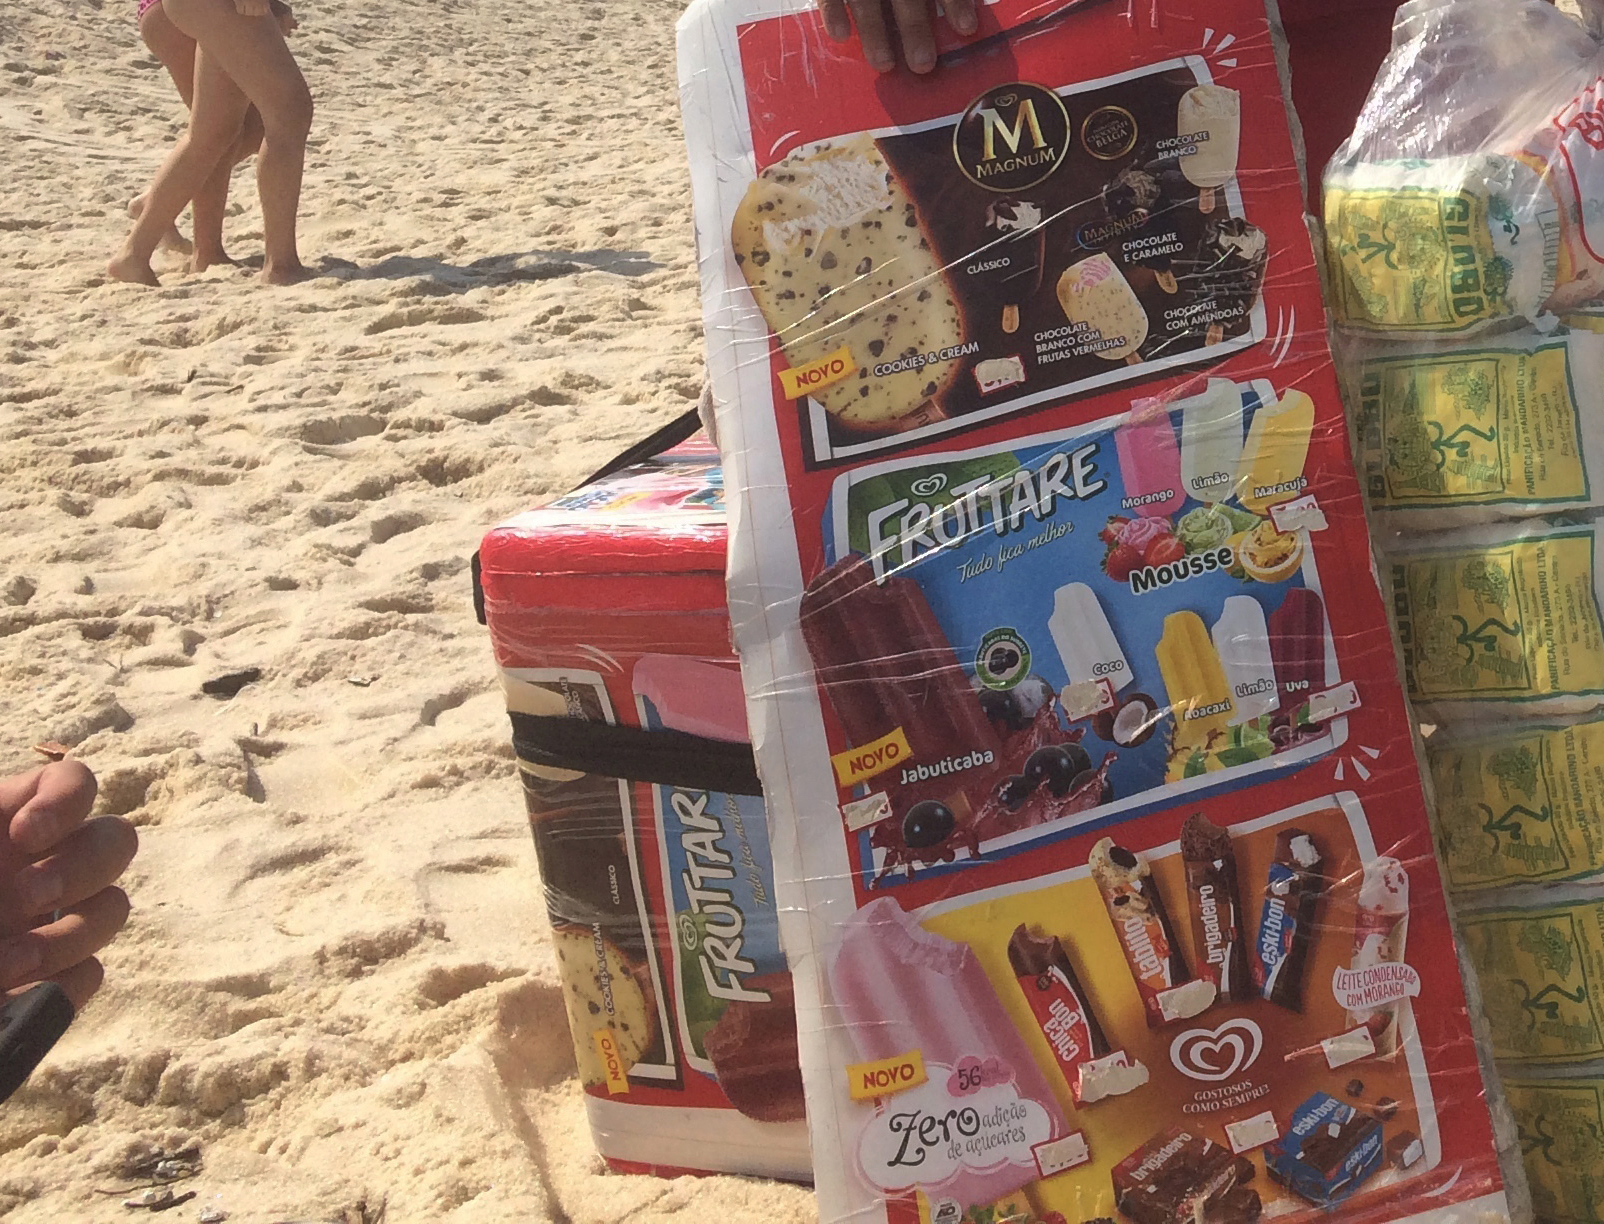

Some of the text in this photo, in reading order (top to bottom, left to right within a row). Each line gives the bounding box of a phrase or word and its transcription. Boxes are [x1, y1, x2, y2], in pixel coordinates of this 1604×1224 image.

[978, 99, 1047, 162] M
[1096, 130, 1128, 148] BELGA
[1156, 131, 1208, 150] CHOCOLATE
[976, 147, 1057, 179] MAGNUM
[1157, 145, 1198, 160] BRANCO
[1122, 232, 1178, 252] CHOCOLATE
[1124, 242, 1184, 262] E CARAMELO
[1034, 322, 1087, 342] CHOCOLATE
[1166, 306, 1244, 331] COM AMÊNDOAS
[1035, 331, 1101, 354] BRANCO COM
[1037, 336, 1126, 365] FRUTAS VERMELHAS
[873, 341, 980, 377] COOKIES & CREAM
[796, 359, 844, 389] NOVO
[1523, 436, 1535, 495] PANIFICAÇÃO
[1191, 472, 1229, 490] Limão
[1253, 476, 1308, 498] Maracujá
[1121, 488, 1174, 510] Morango
[868, 444, 1103, 586] FRUTTARE
[1027, 519, 1075, 550] melhor
[1131, 547, 1234, 594] Mousse
[1540, 570, 1553, 627] MANDARINO
[1093, 659, 1124, 675] Coco
[1546, 627, 1560, 690] PANIFICAÇÃO
[1236, 679, 1274, 698] Limão
[1286, 680, 1310, 693] Uva
[849, 742, 900, 775] NOVO
[900, 749, 994, 785] Jabuticaba
[671, 785, 771, 1002] FRUTTAR
[1199, 884, 1224, 965] brigadeiro
[1124, 916, 1163, 980] tablito
[601, 969, 614, 1016] COOKIES
[1336, 970, 1362, 991] LEITE
[1346, 990, 1364, 1007] COM
[601, 1038, 621, 1081] NOVO
[863, 1063, 915, 1090] NOVO
[958, 1066, 982, 1090] 56
[1194, 1079, 1252, 1102] GOSTOSOS
[1182, 1099, 1221, 1114] COMO
[886, 1102, 1027, 1167] Zero adição
[947, 1139, 964, 1160] de
[1130, 1131, 1193, 1182] brigadeiro
